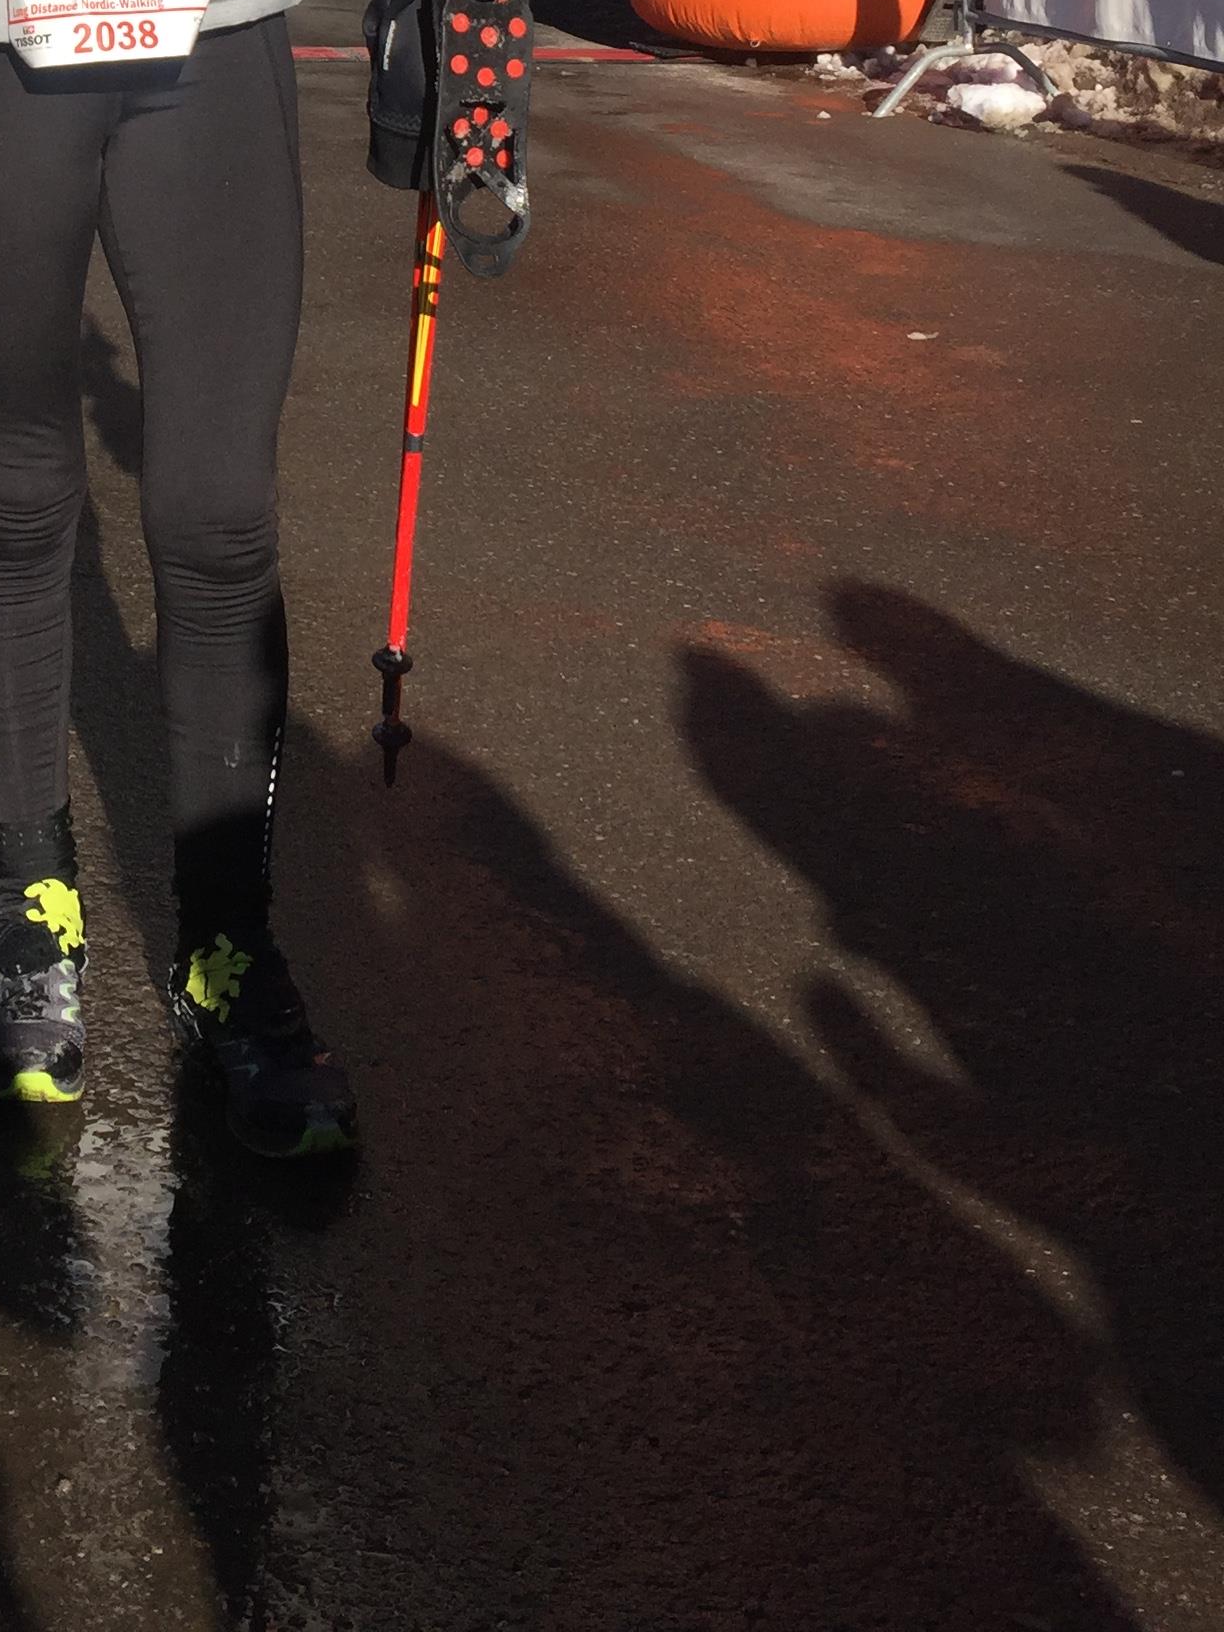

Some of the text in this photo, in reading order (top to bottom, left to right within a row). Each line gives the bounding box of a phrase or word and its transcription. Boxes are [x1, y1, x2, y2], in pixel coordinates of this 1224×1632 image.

[12, 5, 29, 19] Long
[30, 3, 78, 15] Distance
[14, 34, 52, 48] TISSOT
[73, 19, 159, 54] 2038
